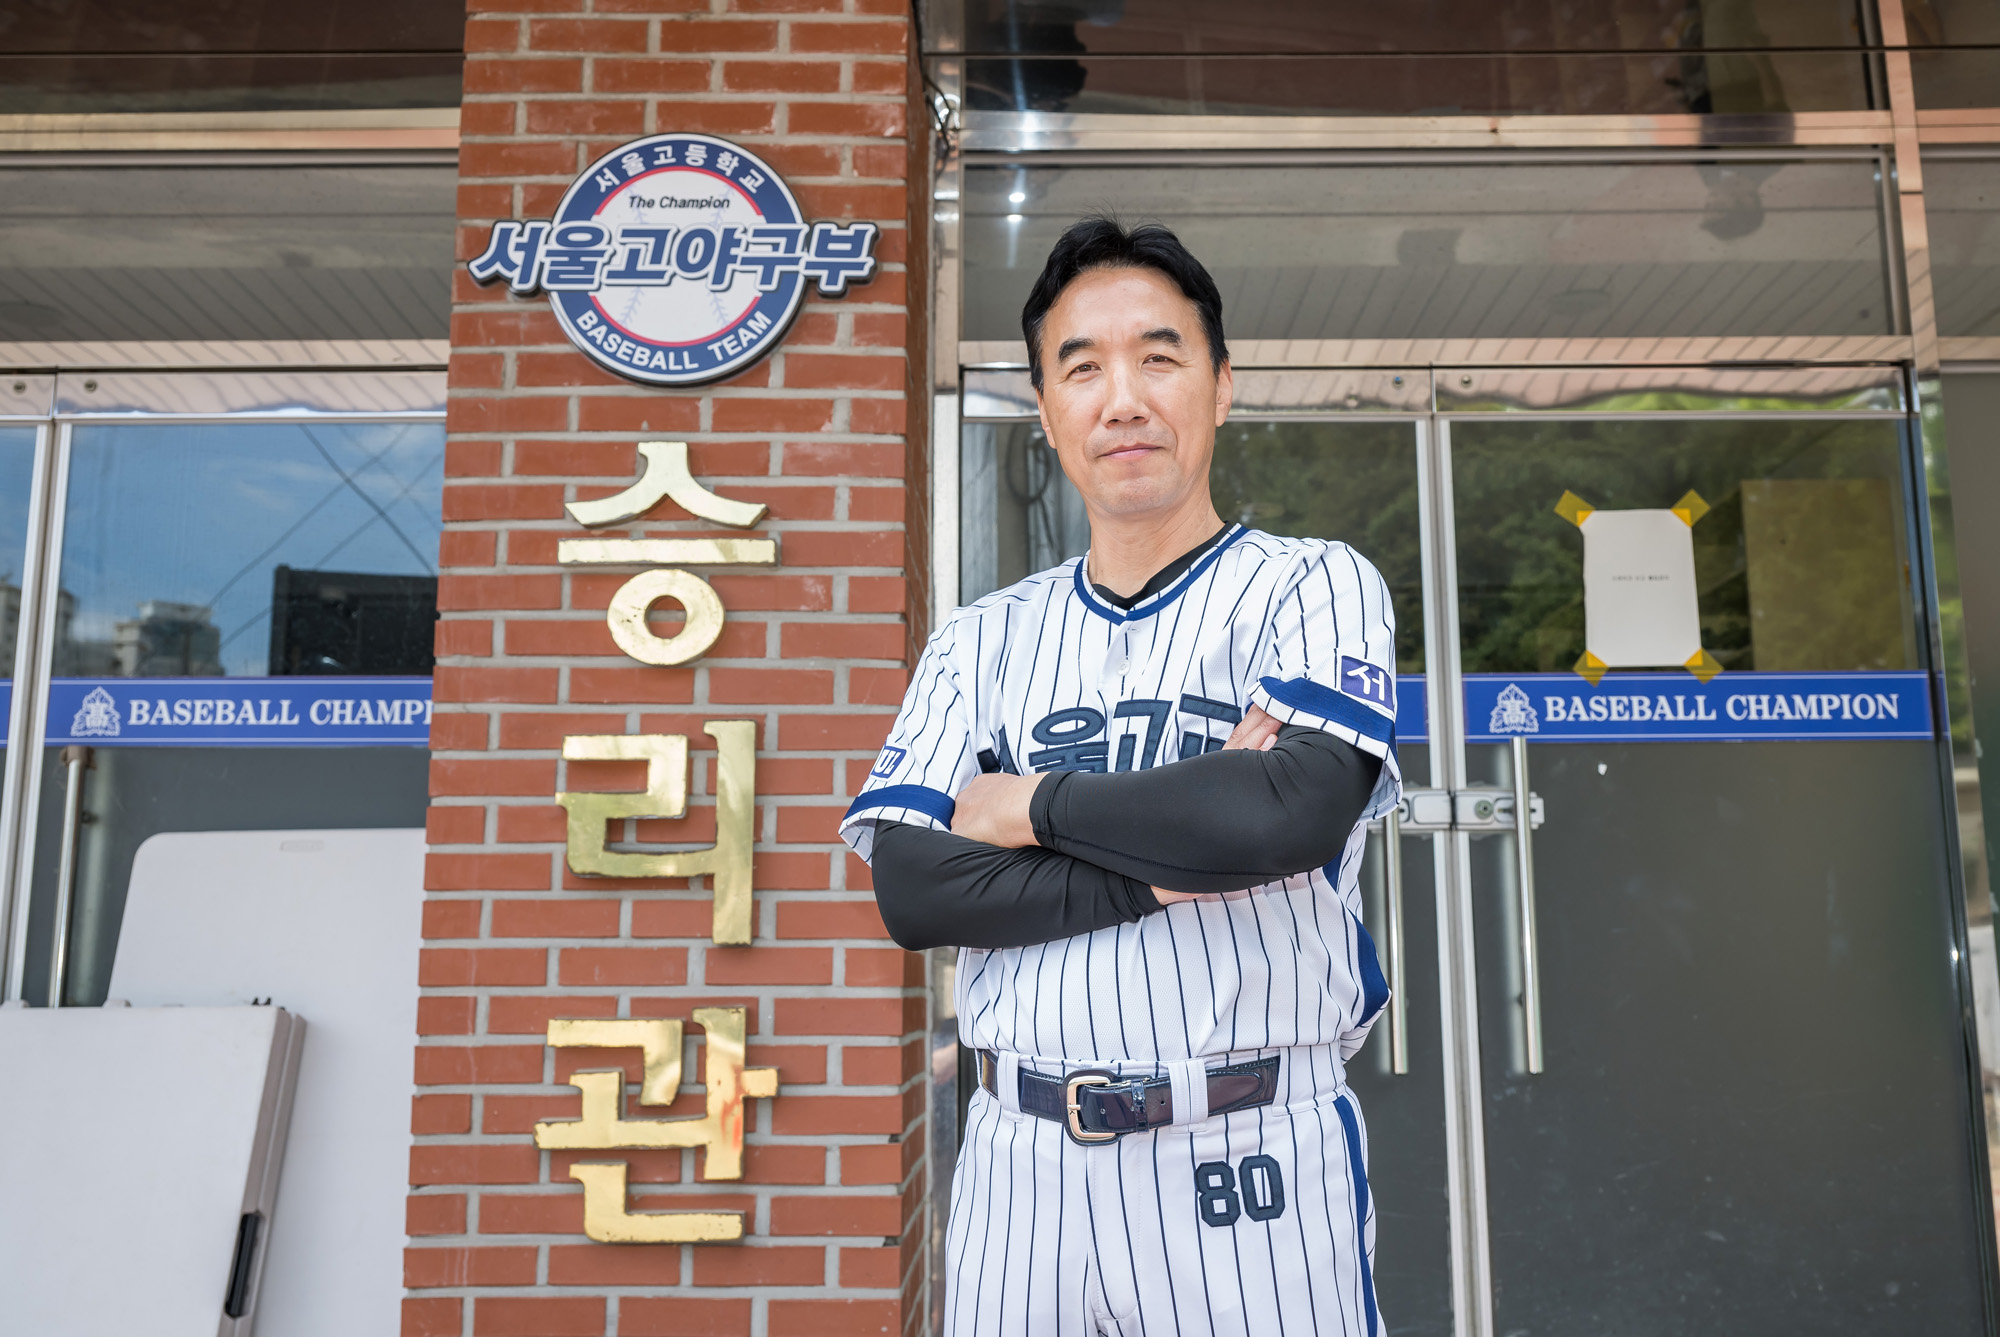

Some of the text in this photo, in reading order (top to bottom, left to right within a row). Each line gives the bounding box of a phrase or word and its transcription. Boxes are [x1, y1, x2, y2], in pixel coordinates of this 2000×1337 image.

[595, 143, 766, 194] 서울고등학교
[628, 195, 731, 210] The Champion
[472, 223, 877, 292] 서울고야구부
[576, 309, 773, 371] BASEBALL TEAM
[1346, 664, 1385, 702] 서
[1543, 694, 1717, 722] BASEBALL
[1725, 693, 1899, 721] CHAMPION
[127, 698, 300, 726] BASEBALL
[309, 698, 433, 726] CHAMPI
[536, 441, 779, 1244] 승리관
[1195, 1154, 1286, 1228] 80
